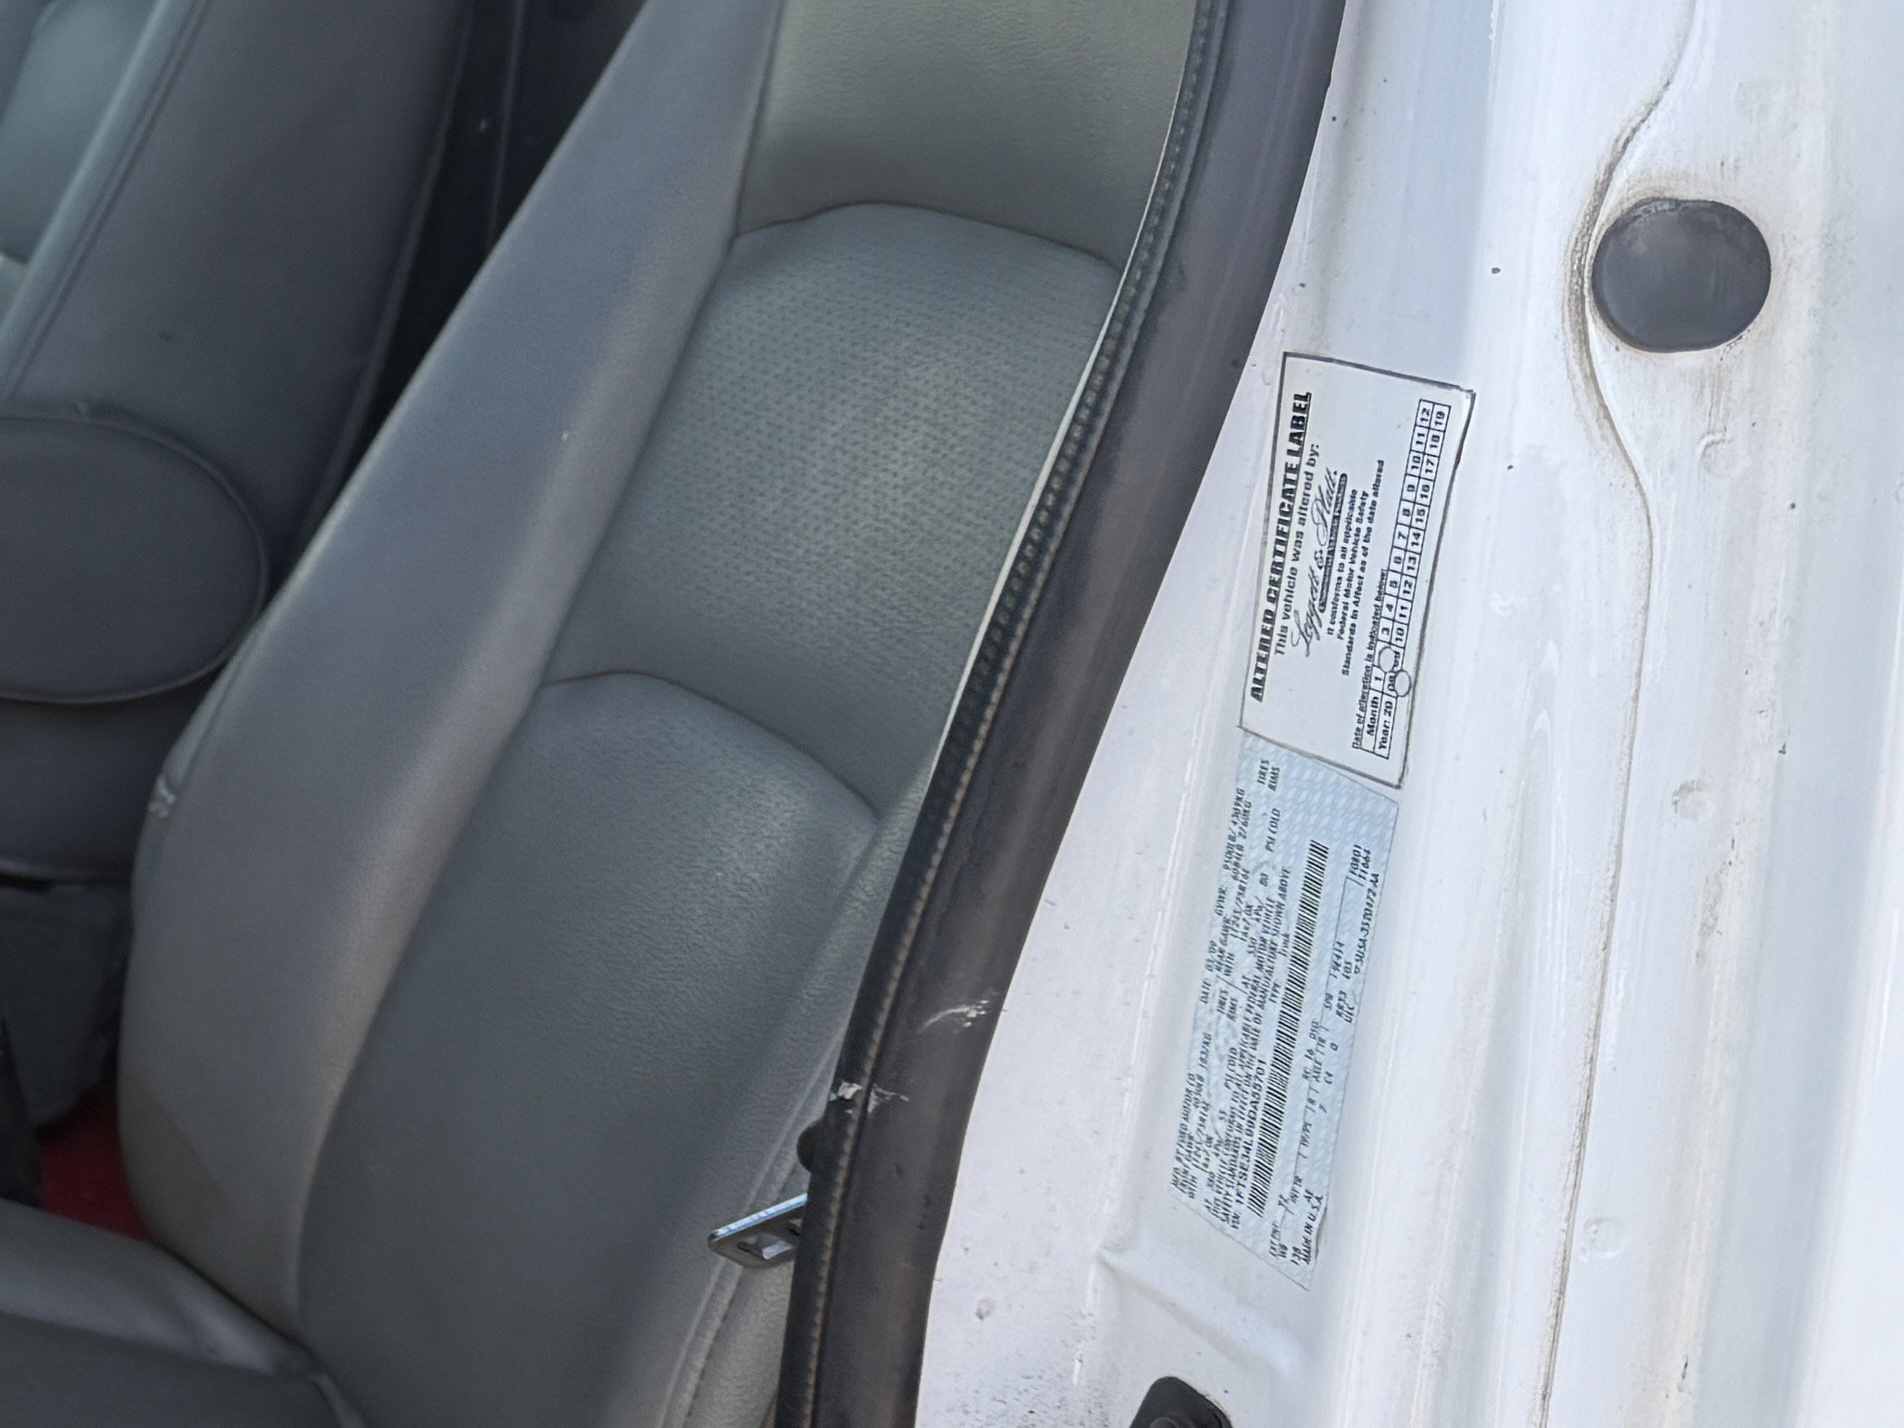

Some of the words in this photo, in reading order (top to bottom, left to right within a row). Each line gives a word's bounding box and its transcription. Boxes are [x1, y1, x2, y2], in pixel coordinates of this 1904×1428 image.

[1250, 609, 1274, 701] ALTERED
[1266, 463, 1297, 603] CERTIFICATE
[1287, 392, 1310, 457] LABEL
[1274, 625, 1287, 654] This
[1282, 567, 1297, 619] vehicle
[1291, 531, 1303, 561] was
[1297, 471, 1313, 525] altered
[1305, 443, 1319, 466] by:
[1366, 696, 1379, 735] Month
